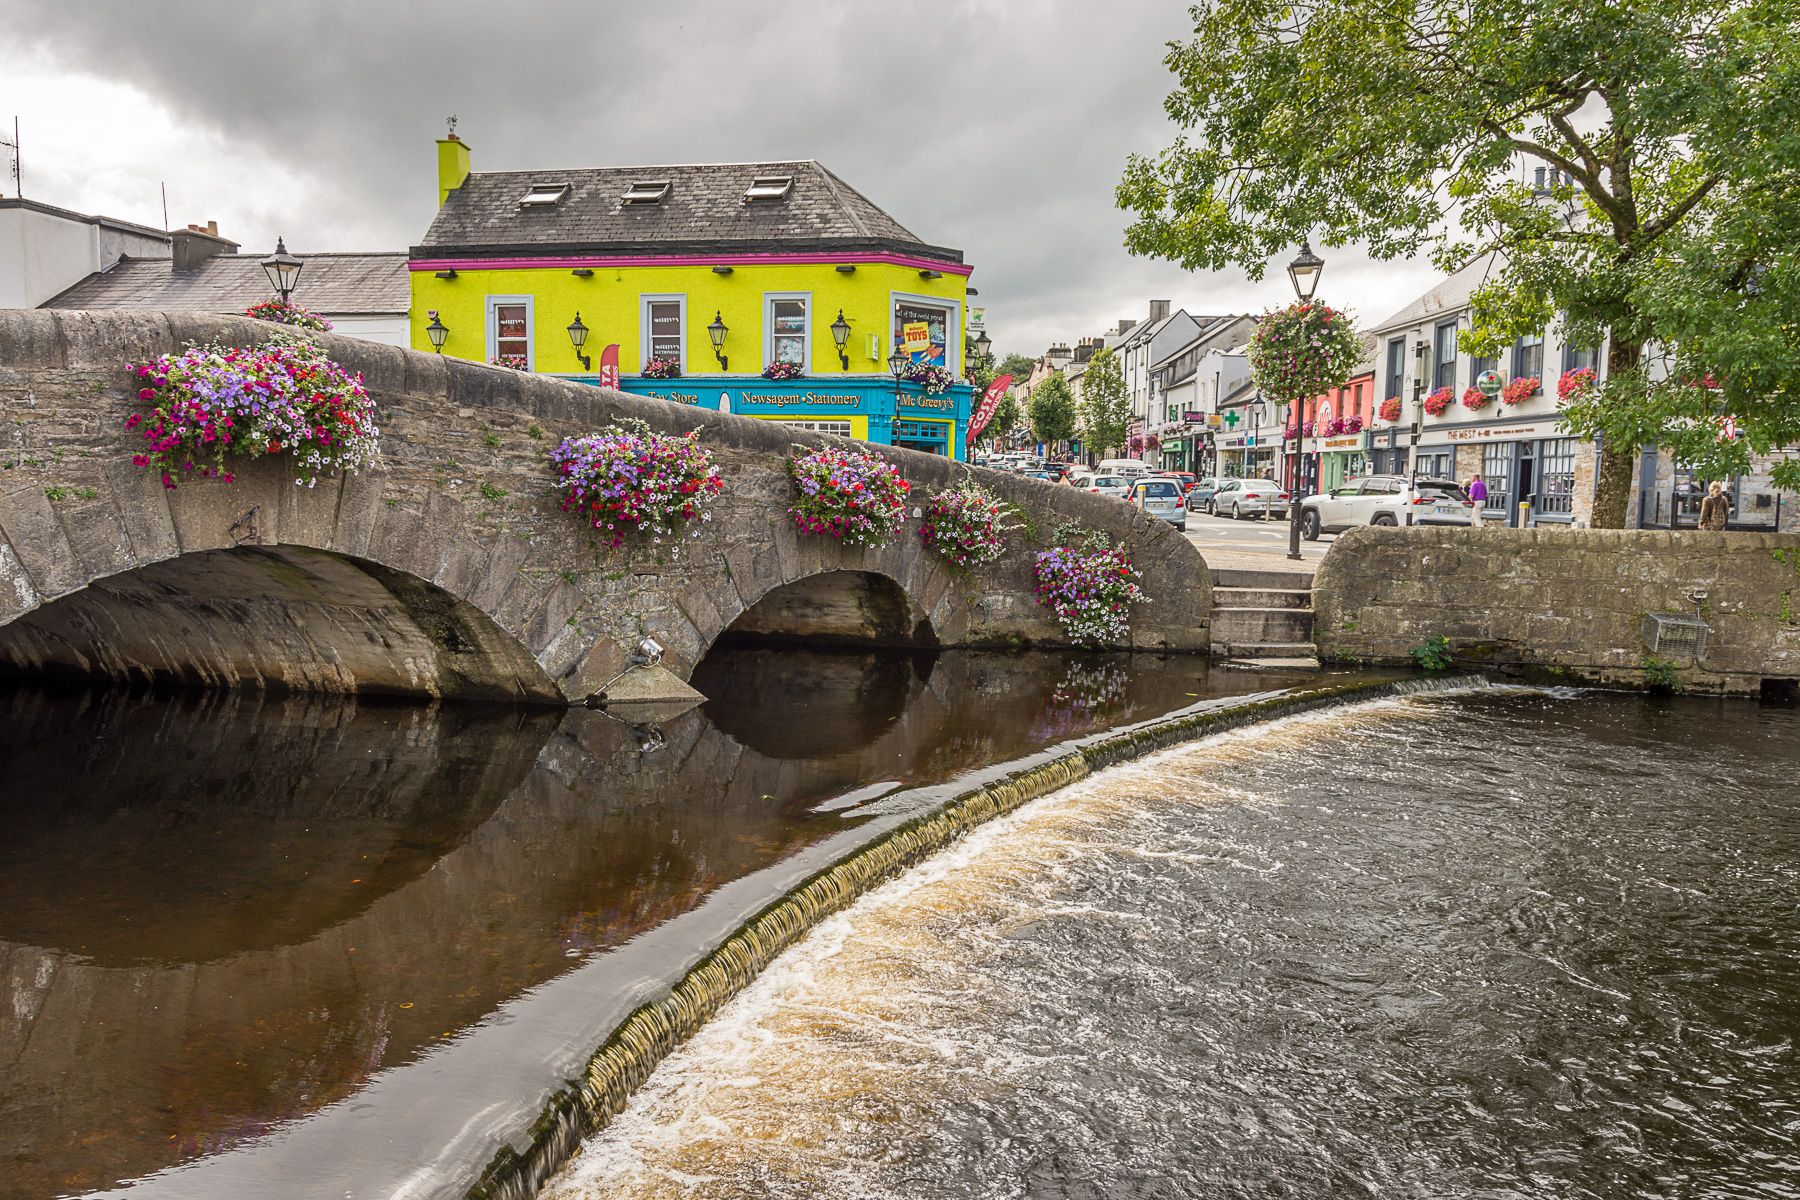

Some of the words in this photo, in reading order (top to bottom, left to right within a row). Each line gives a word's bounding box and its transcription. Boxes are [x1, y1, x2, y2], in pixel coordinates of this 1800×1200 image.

[904, 310, 908, 318] of
[906, 330, 928, 342] TOYS
[908, 340, 929, 349] DIRECT
[670, 391, 699, 404] Store
[741, 391, 801, 408] Newsagent
[806, 391, 862, 408] Stationery
[900, 394, 916, 407] Mc
[916, 395, 955, 412] Greevy's
[972, 388, 999, 430] COSTA
[985, 390, 1005, 421] EXPRESS
[1447, 430, 1458, 440] THE
[1458, 429, 1476, 440] WEST
